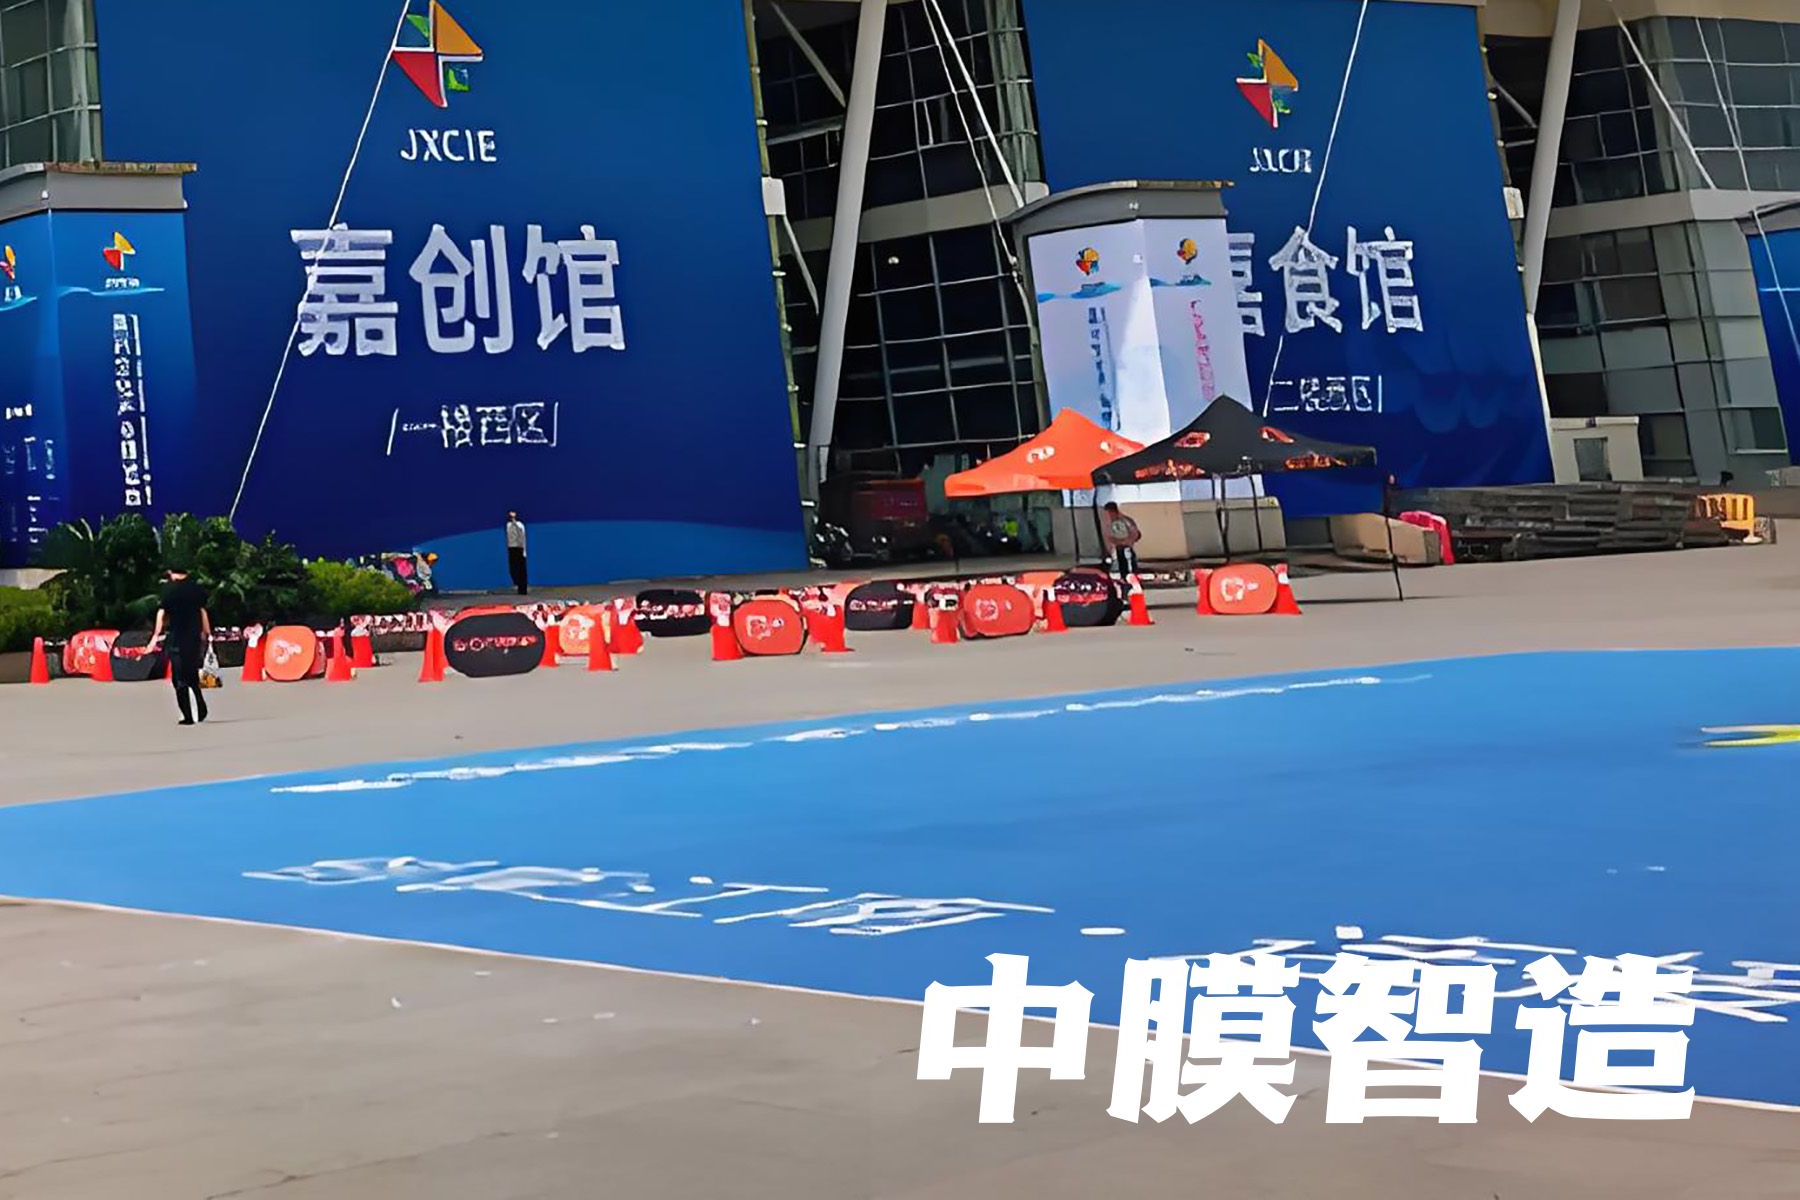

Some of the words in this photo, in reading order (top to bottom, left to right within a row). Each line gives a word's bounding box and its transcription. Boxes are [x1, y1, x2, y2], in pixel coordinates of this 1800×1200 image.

[400, 129, 497, 162] JXCIE
[290, 223, 626, 357] 嘉创馆
